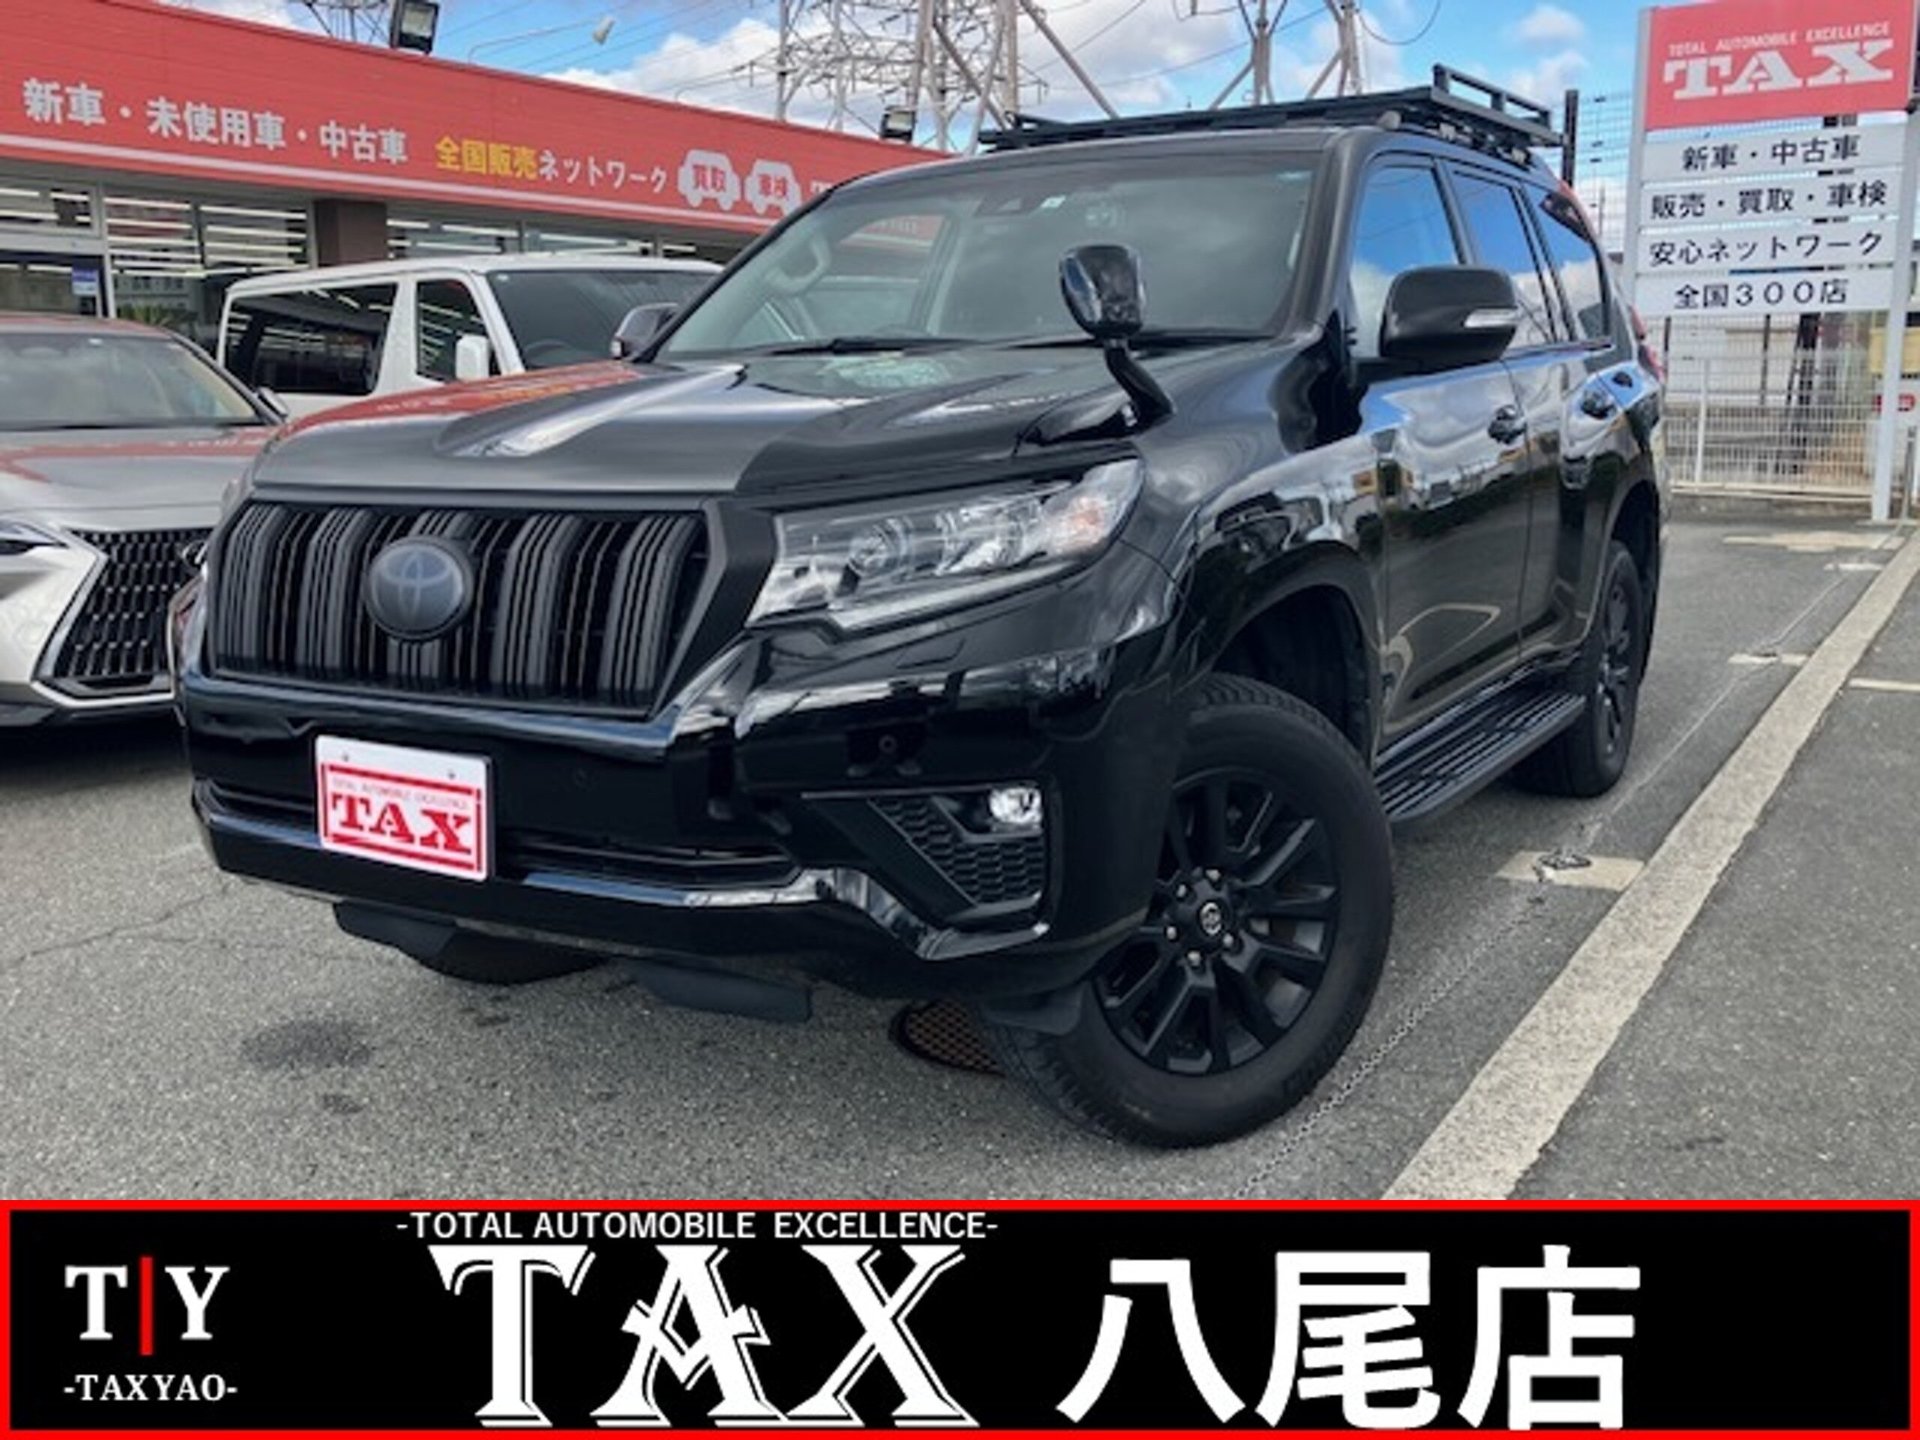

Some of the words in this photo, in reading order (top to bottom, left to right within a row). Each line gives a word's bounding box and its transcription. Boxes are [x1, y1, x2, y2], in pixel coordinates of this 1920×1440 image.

[1668, 41, 1708, 57] TOTAL
[1715, 31, 1797, 52] AUTOMOBILE
[1805, 21, 1890, 43] EXCELLENCE
[1663, 39, 1894, 100] TAX
[1650, 232, 1883, 267] 安心ネットワーク
[332, 793, 472, 855] TAX
